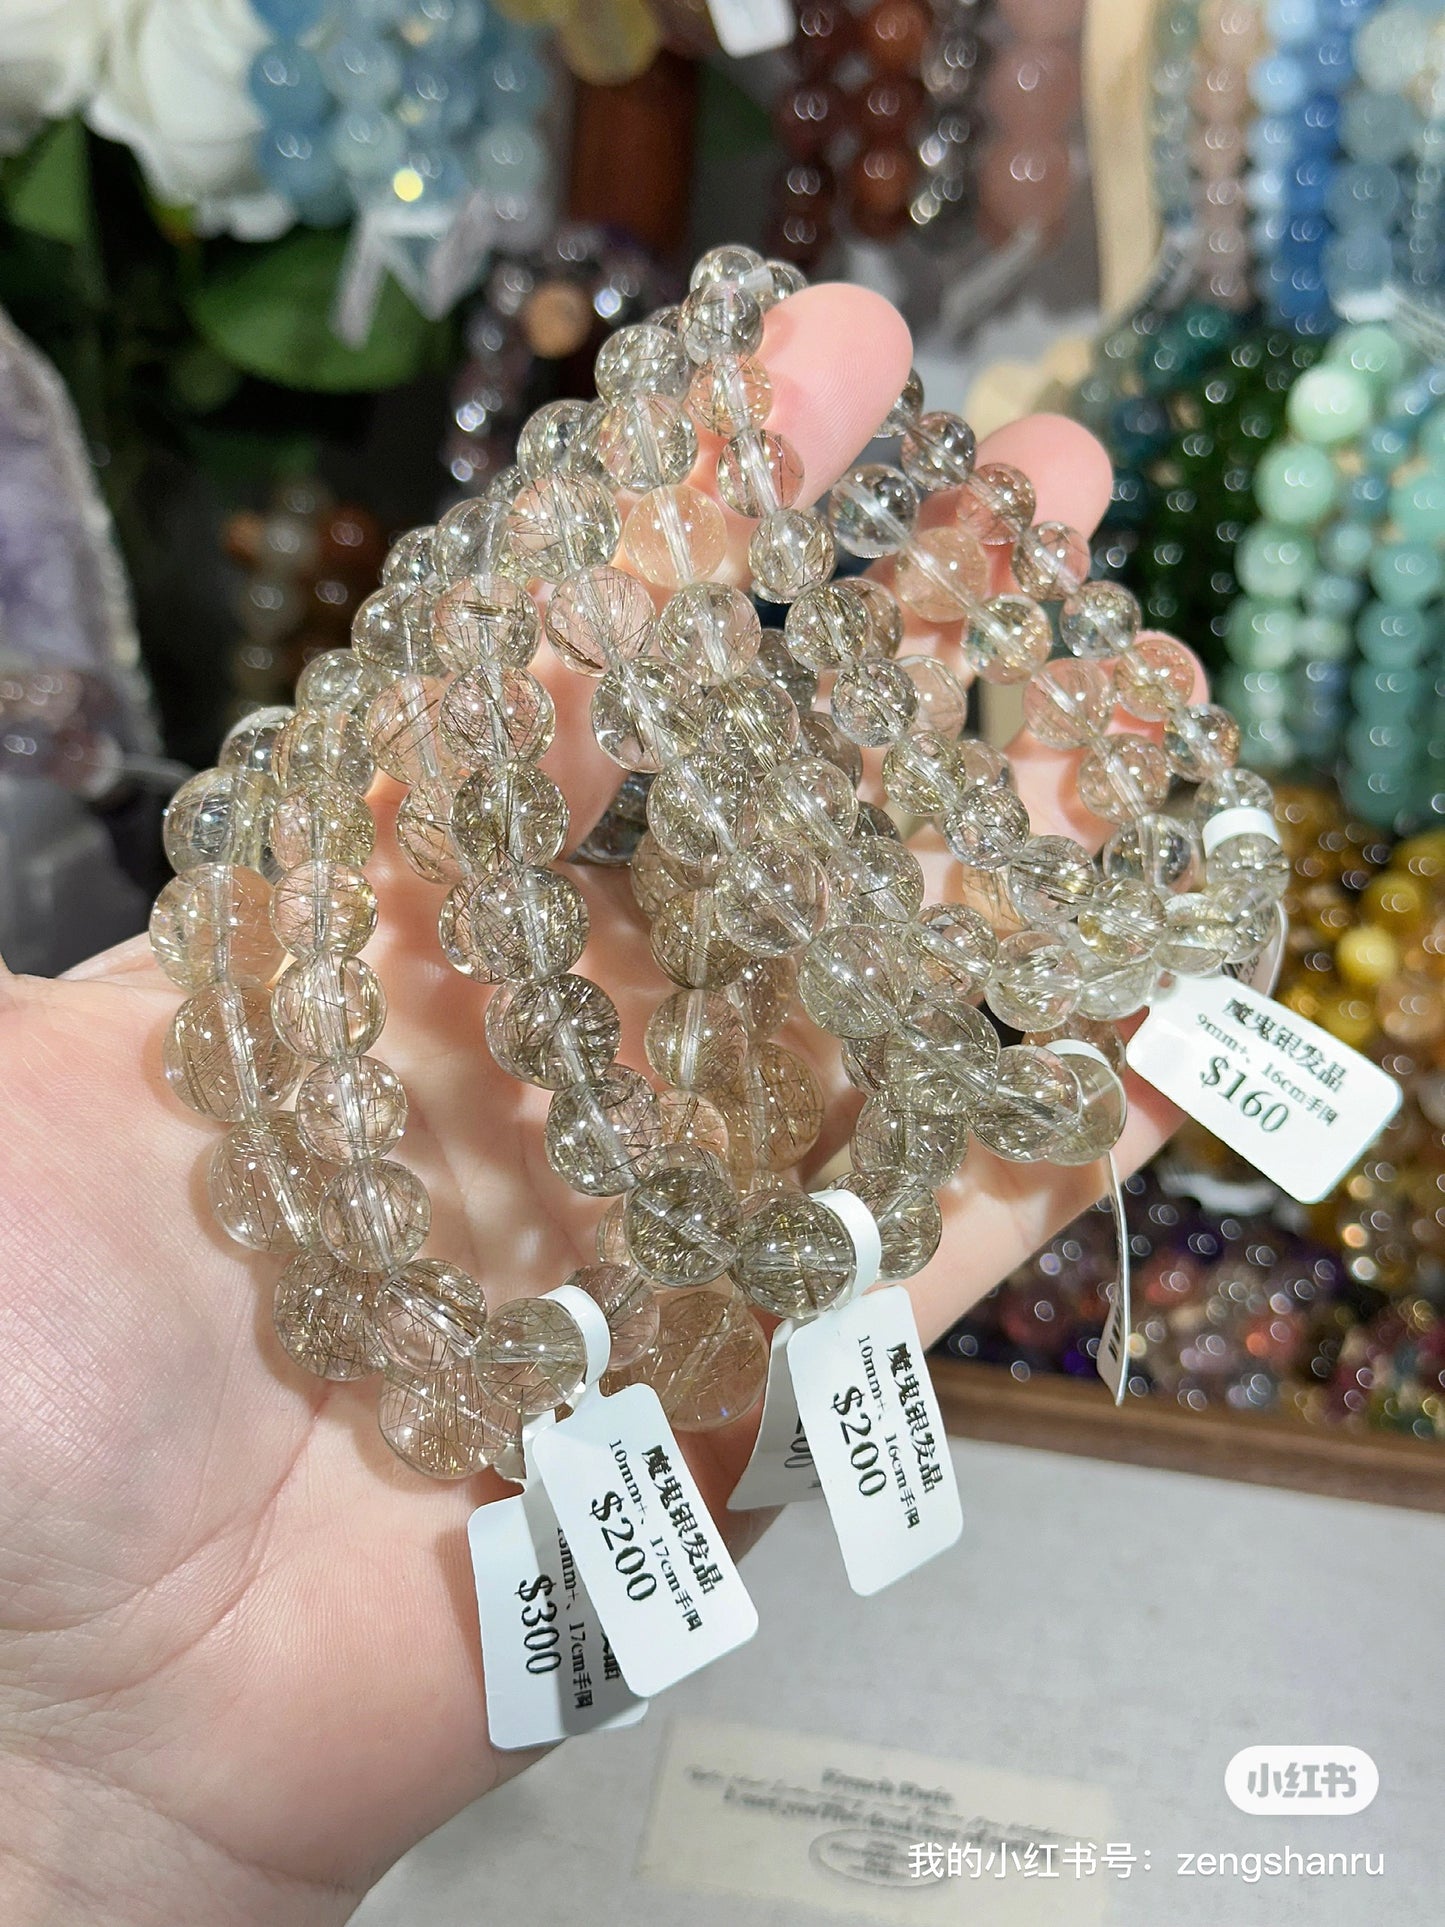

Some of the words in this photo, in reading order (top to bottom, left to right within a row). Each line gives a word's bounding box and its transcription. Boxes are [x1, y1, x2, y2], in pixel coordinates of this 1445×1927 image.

[1200, 1055, 1289, 1132] $160
[1223, 998, 1346, 1092] 魔鬼银发晶
[831, 1386, 887, 1497] $200
[886, 1342, 943, 1494] 魔鬼银发晶
[590, 1490, 658, 1602] $200
[641, 1444, 724, 1595] 魔鬼银发晶
[514, 1574, 563, 1675] $300
